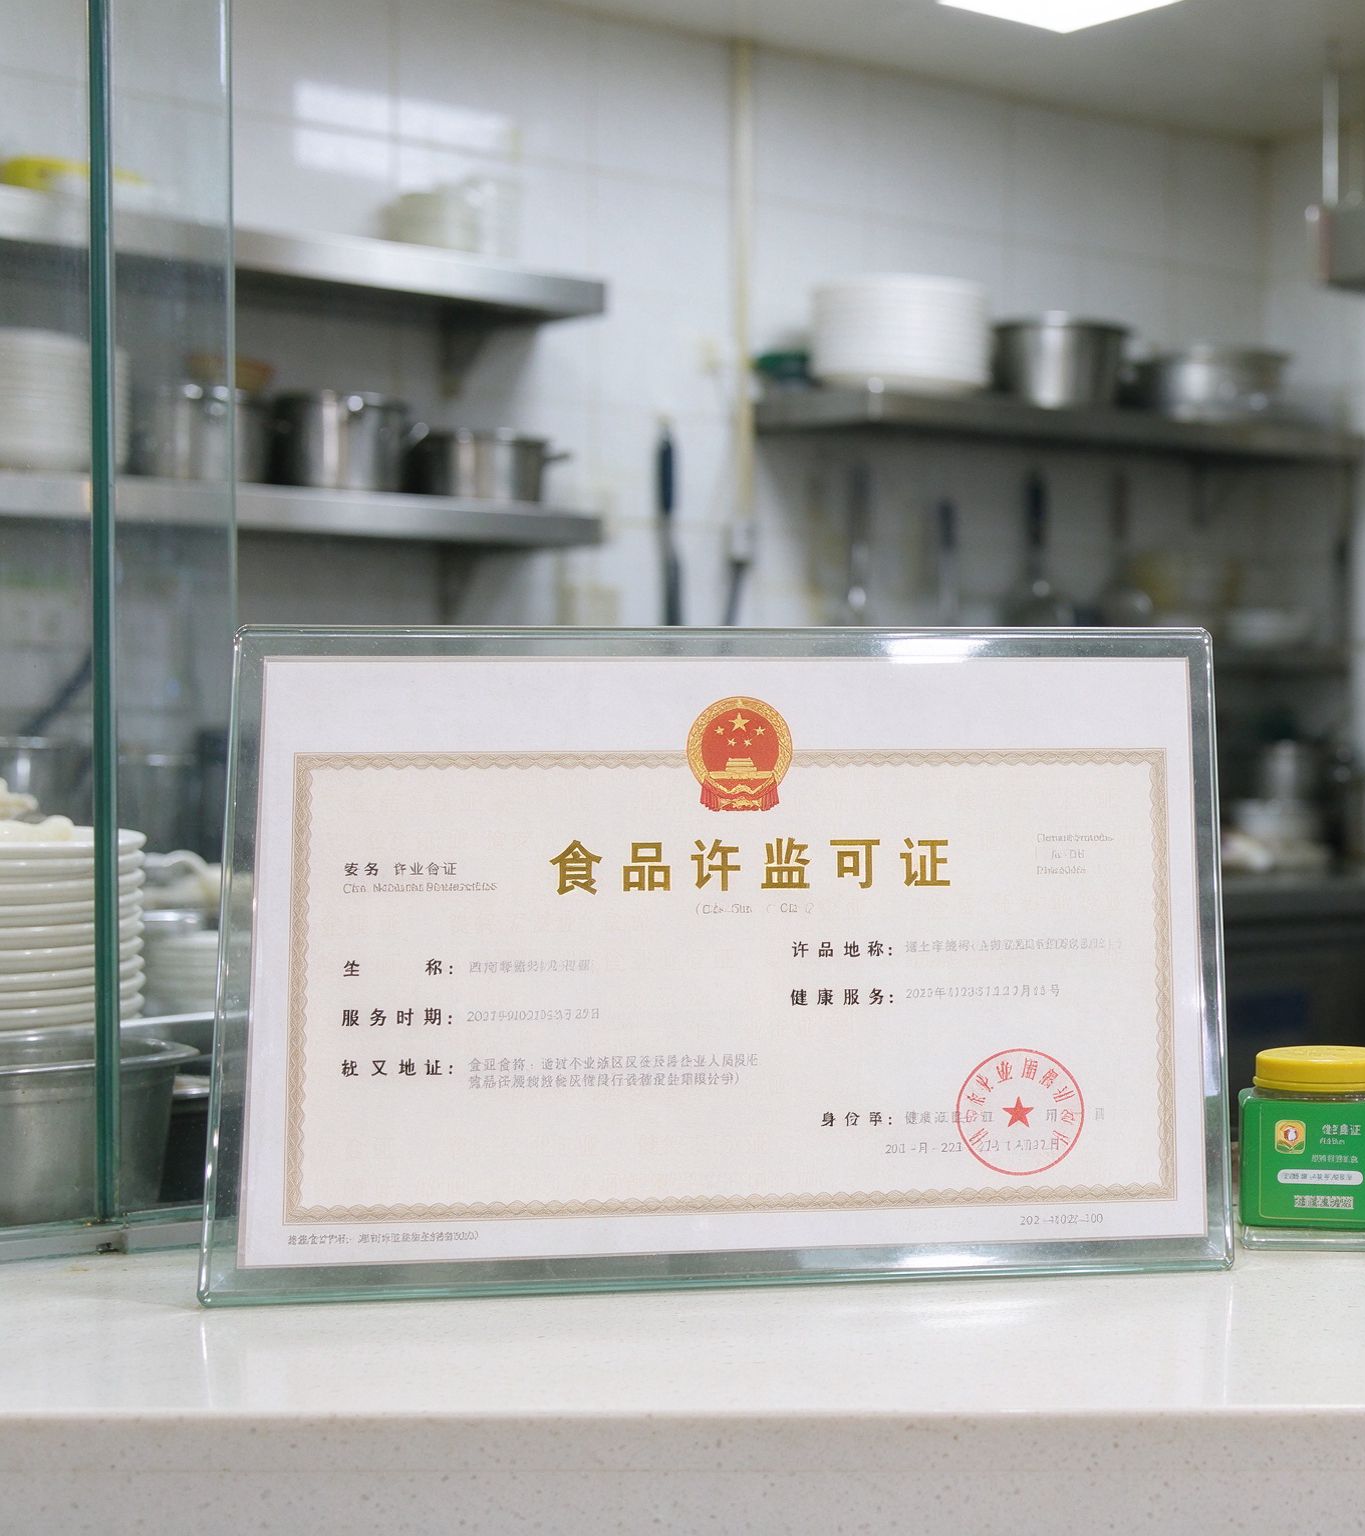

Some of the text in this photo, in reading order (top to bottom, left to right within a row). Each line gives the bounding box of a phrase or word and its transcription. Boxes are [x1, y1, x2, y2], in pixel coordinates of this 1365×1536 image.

[549, 836, 951, 896] 食品许监可证
